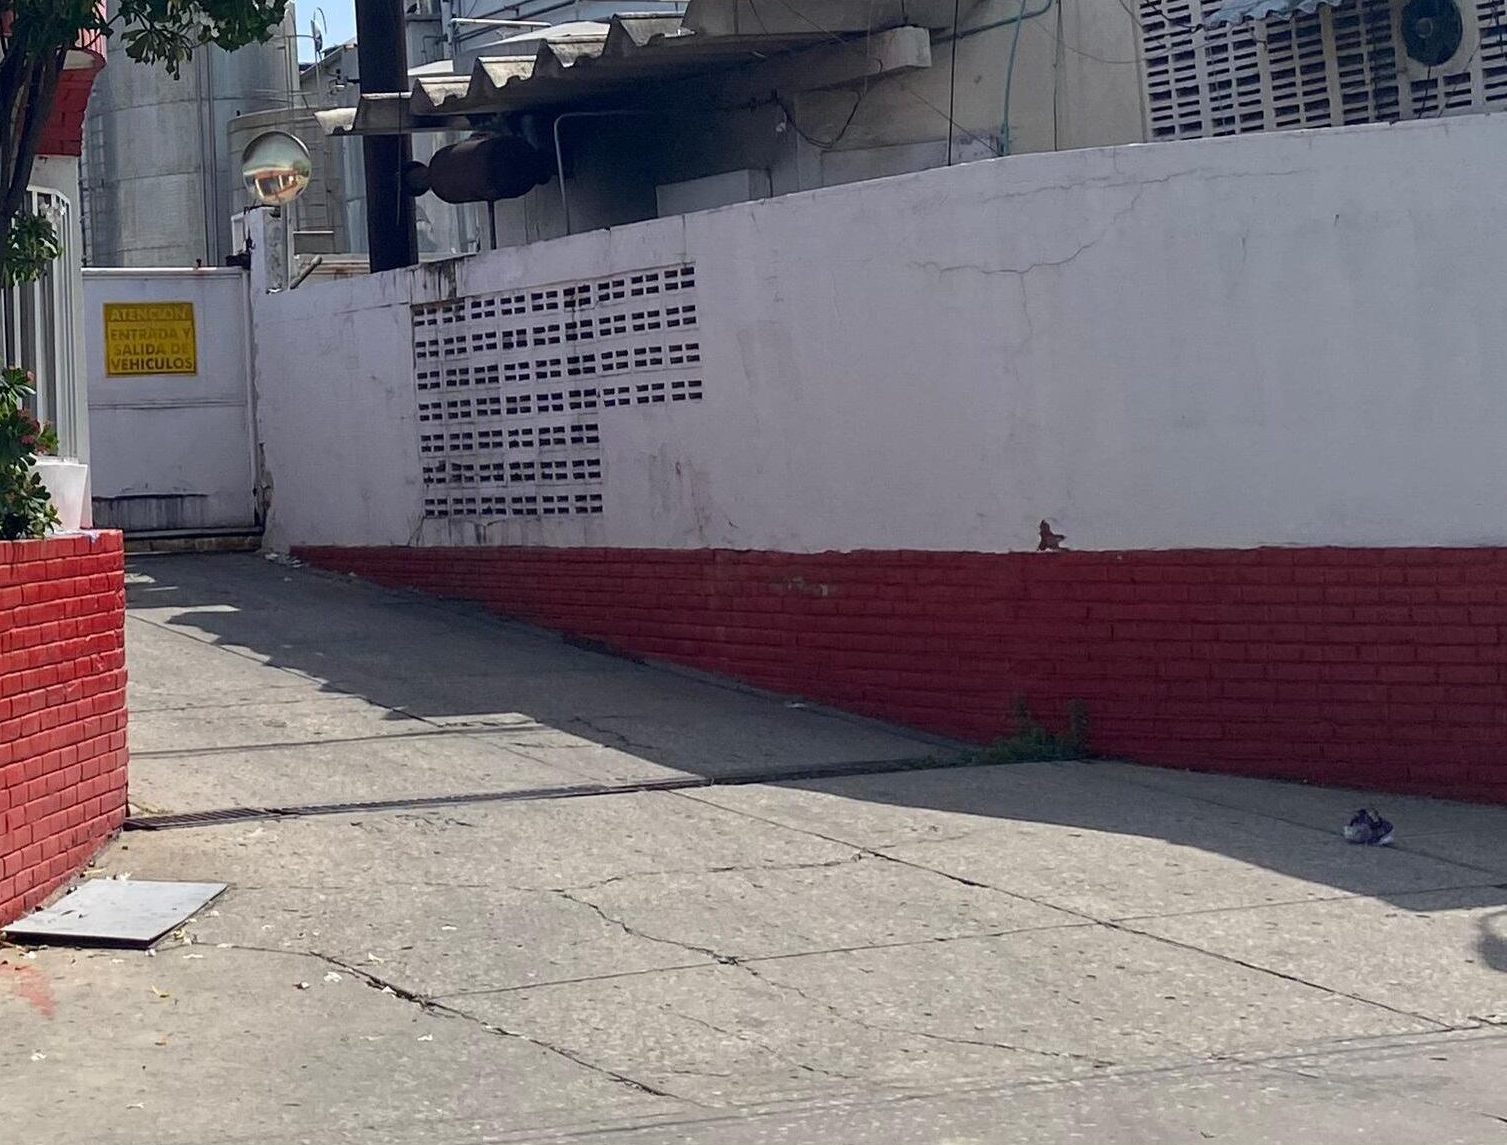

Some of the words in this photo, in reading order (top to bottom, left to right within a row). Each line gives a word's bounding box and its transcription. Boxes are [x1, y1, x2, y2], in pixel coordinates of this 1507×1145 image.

[110, 328, 178, 340] ENTRADA
[183, 327, 191, 339] Y
[114, 343, 166, 356] SALIDA
[171, 342, 191, 355] DE
[111, 357, 192, 370] VEHICULOS
